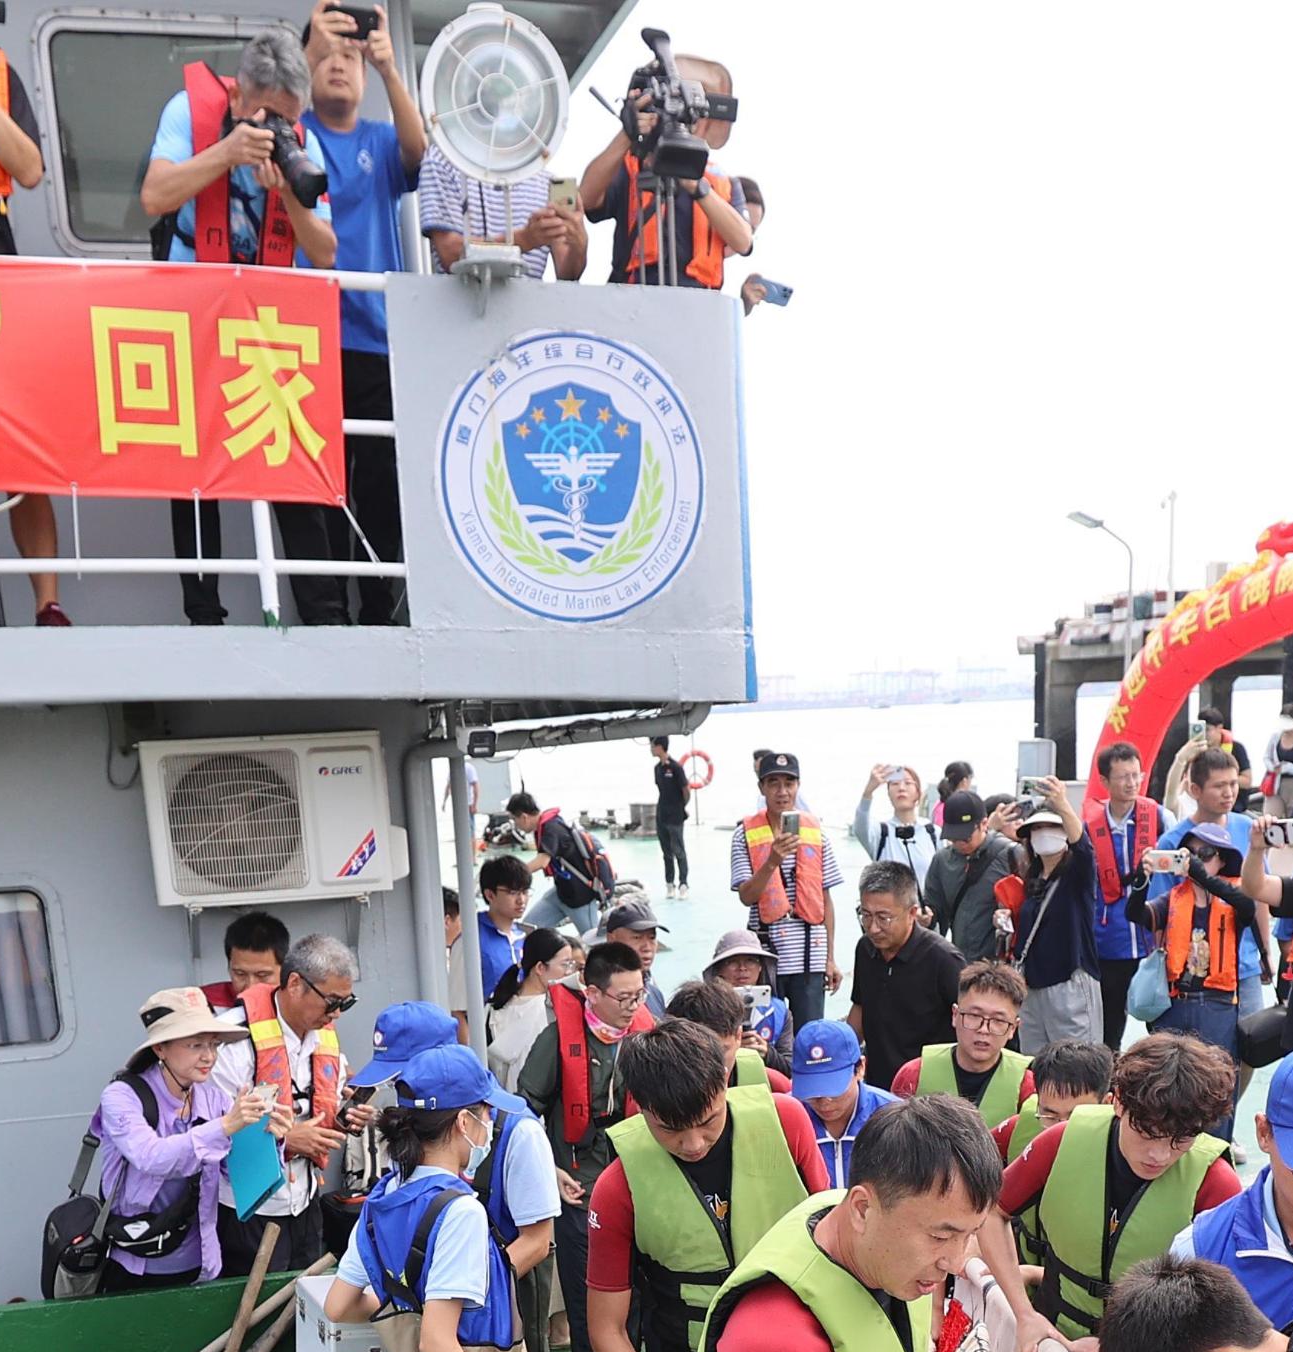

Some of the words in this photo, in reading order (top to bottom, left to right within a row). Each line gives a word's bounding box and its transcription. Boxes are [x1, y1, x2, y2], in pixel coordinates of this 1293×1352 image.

[455, 342, 687, 447] 厦门海洋综合行政执法
[460, 509, 494, 563] Xiamen
[493, 559, 560, 608] Integrated
[565, 592, 612, 610] Marine
[617, 580, 643, 601] Law
[643, 499, 692, 583] Enforcement
[331, 764, 363, 775] GREE
